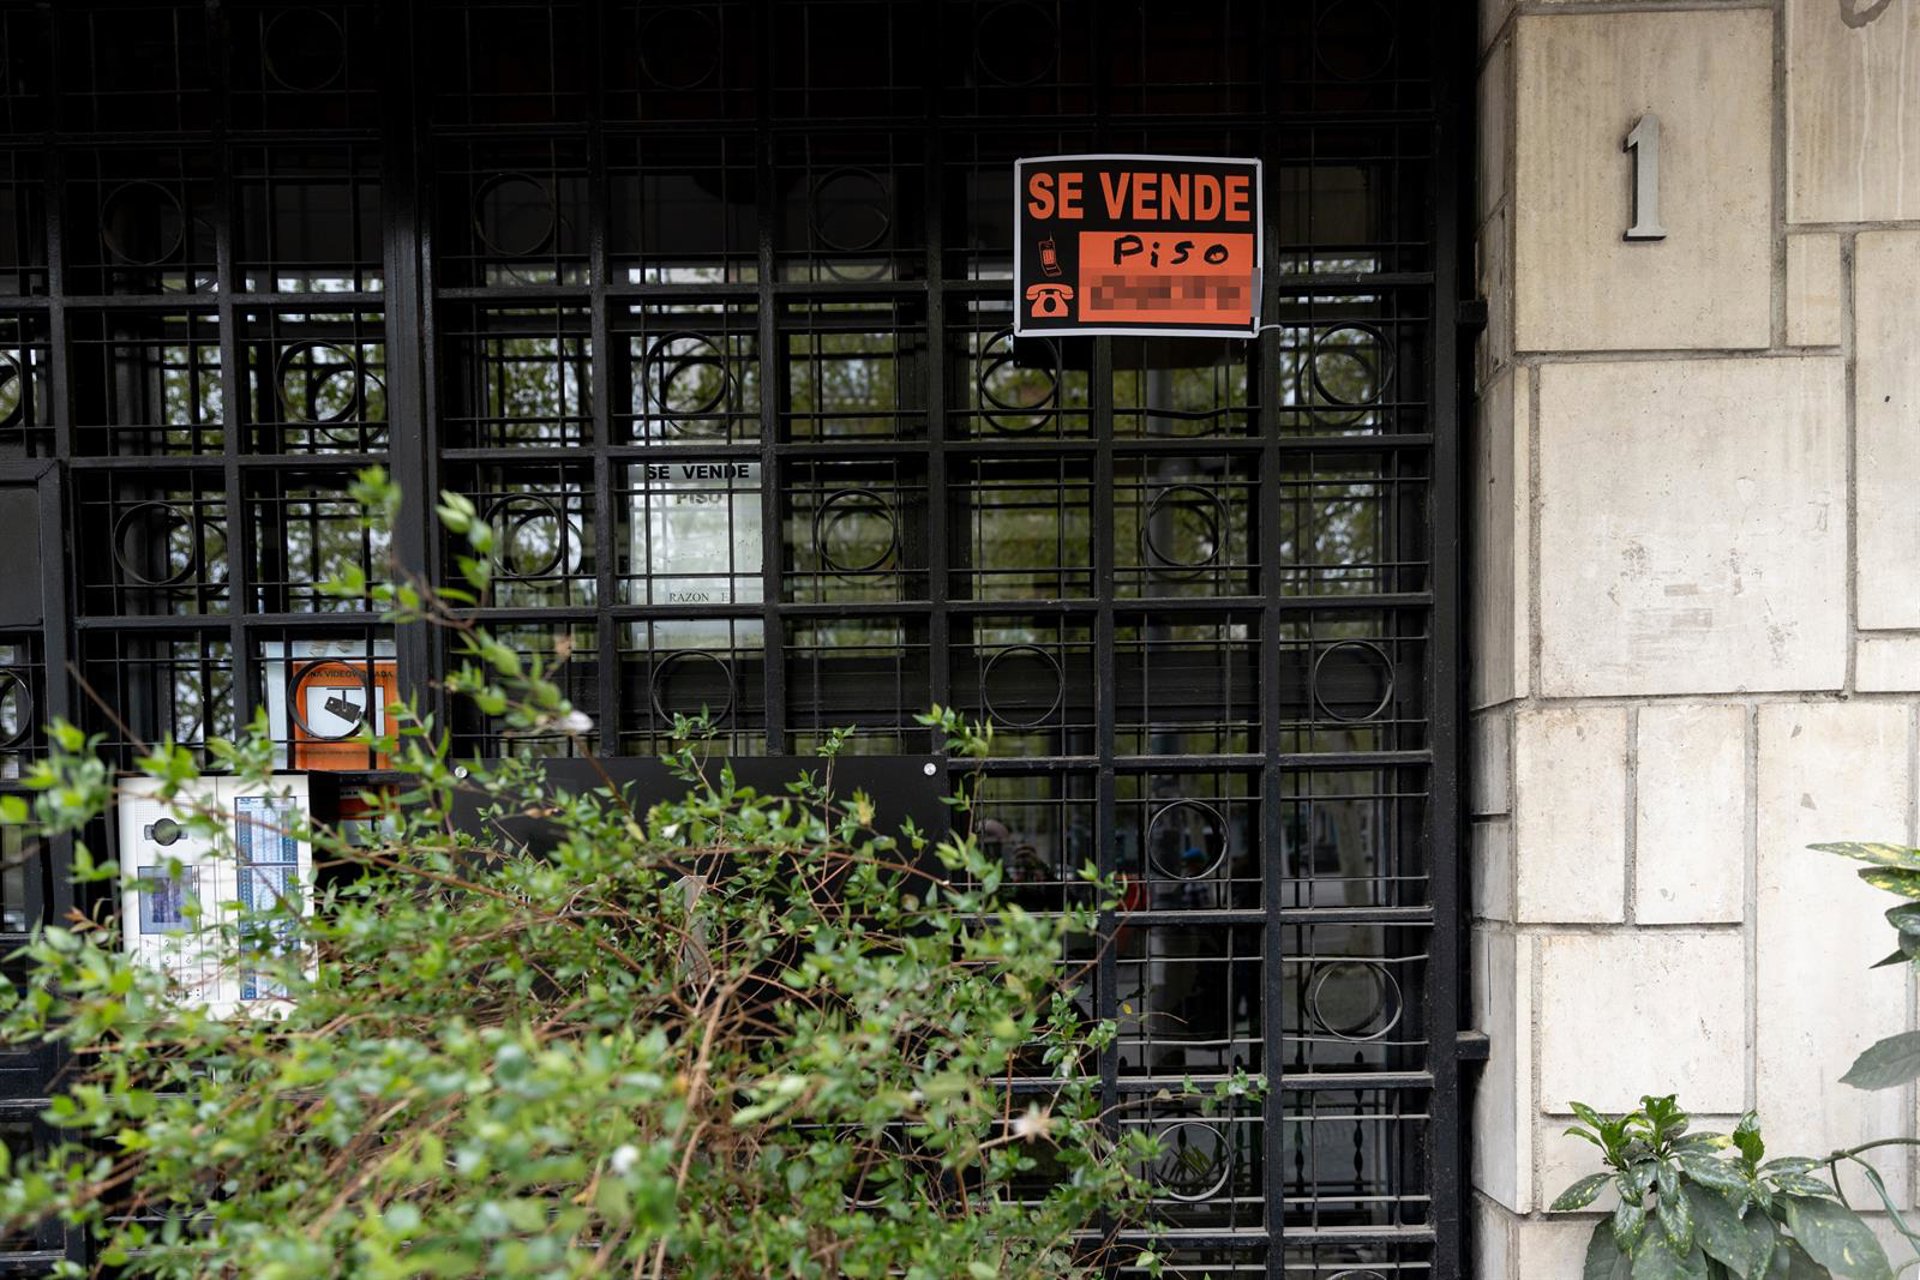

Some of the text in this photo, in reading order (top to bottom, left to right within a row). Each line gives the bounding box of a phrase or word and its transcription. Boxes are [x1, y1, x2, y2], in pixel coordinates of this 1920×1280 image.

[1624, 114, 1667, 240] 1
[1028, 172, 1250, 222] SE VENDE
[682, 464, 749, 480] VENDE
[669, 592, 709, 602] RAZON
